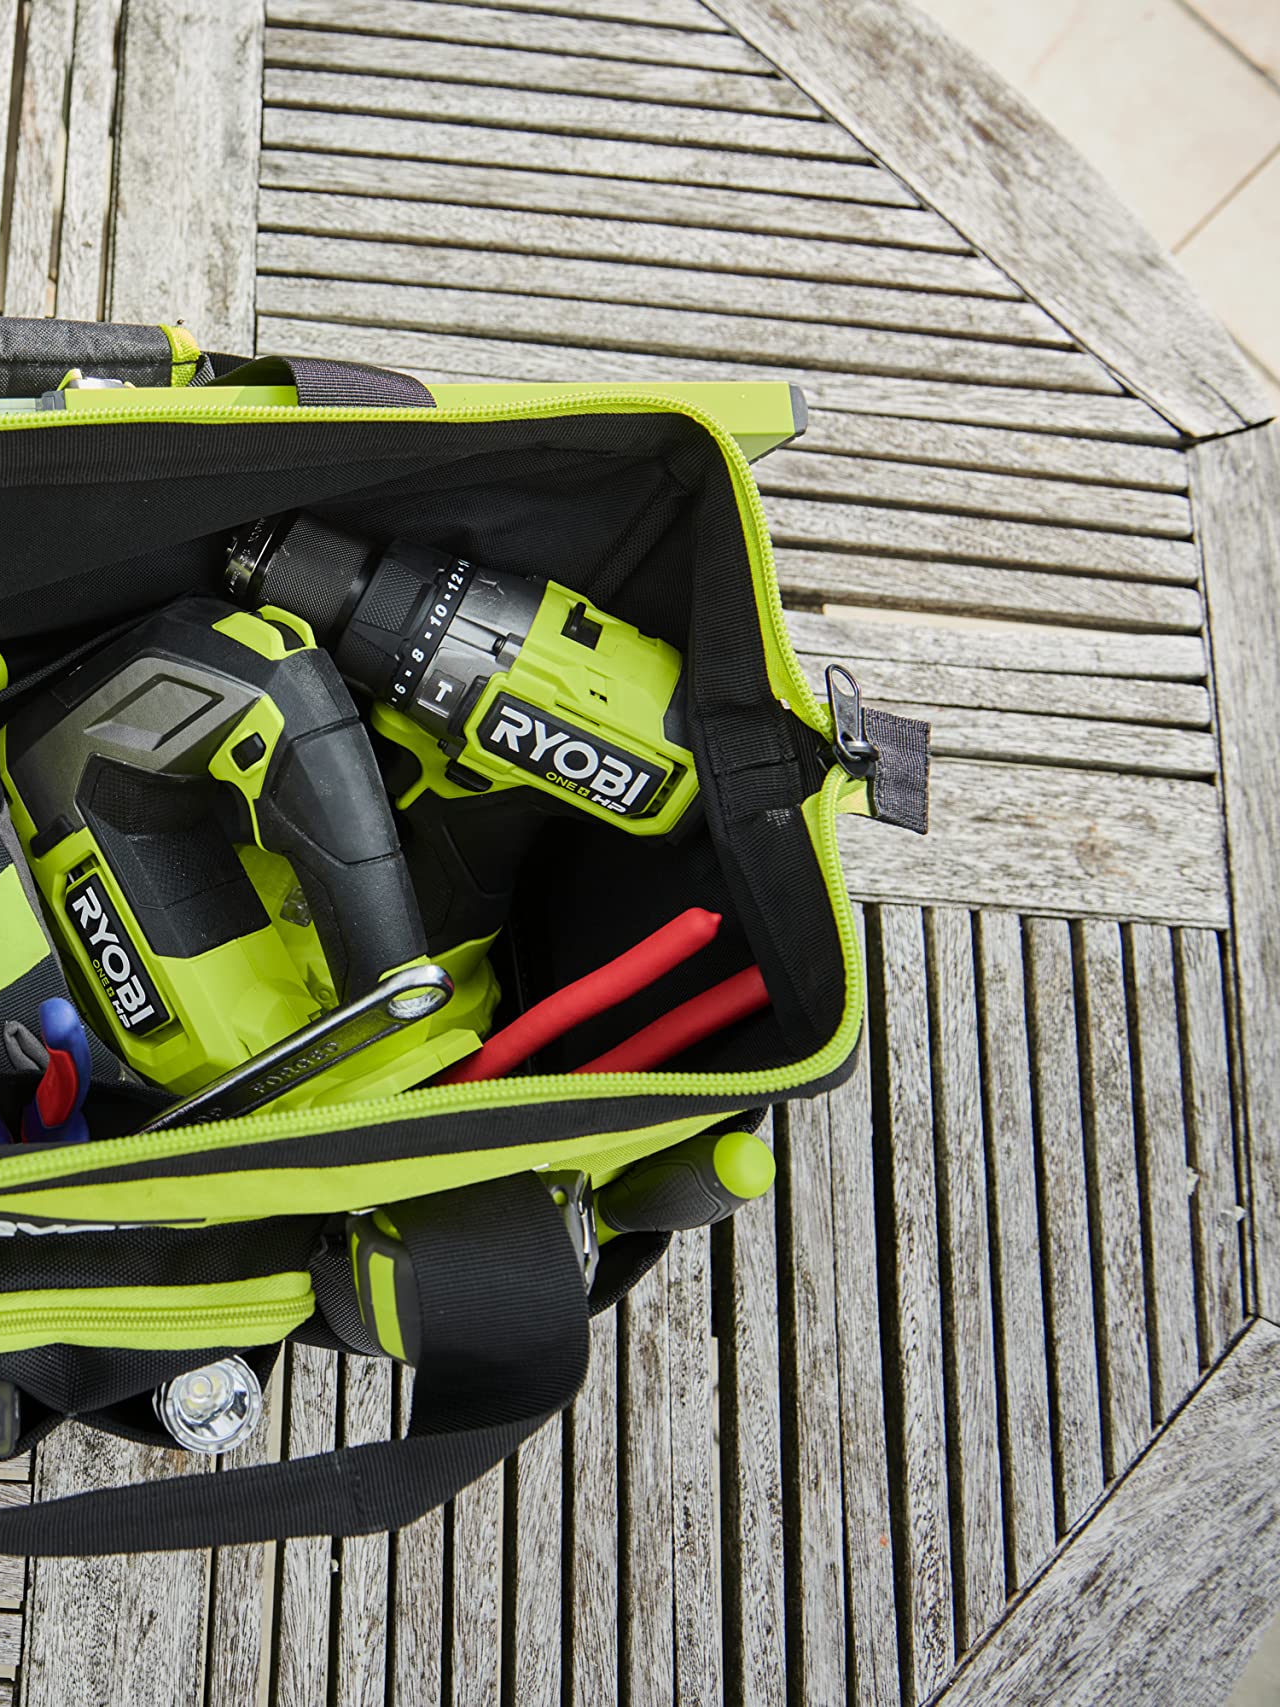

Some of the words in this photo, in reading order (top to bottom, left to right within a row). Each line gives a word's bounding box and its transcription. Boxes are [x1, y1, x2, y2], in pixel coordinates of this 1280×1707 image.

[394, 682, 407, 695] 6
[411, 648, 425, 663] 8
[429, 603, 448, 627] 10
[447, 573, 464, 591] 12
[490, 705, 650, 806] RYOBI
[591, 793, 628, 813] HP
[71, 886, 156, 1026] RYOBI
[111, 1000, 131, 1029] HP
